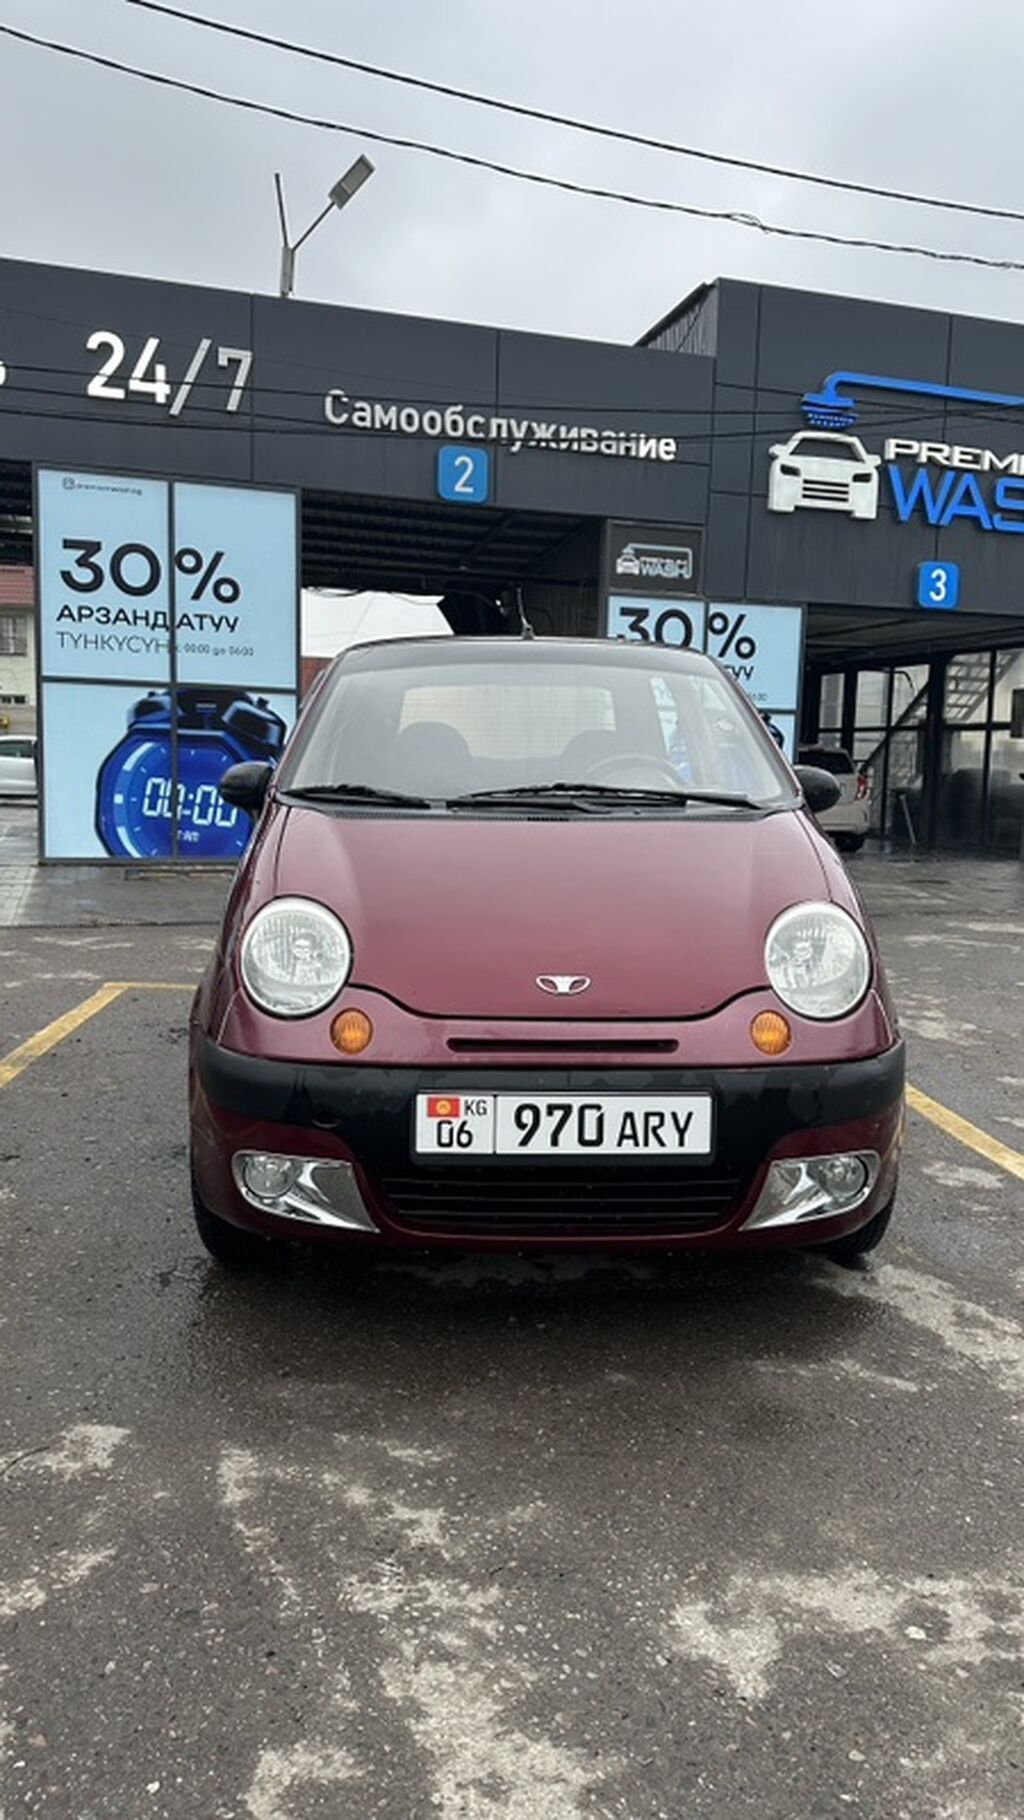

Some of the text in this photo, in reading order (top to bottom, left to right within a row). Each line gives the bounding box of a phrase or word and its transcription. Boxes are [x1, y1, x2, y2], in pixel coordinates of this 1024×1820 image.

[86, 331, 252, 416] 24/7
[324, 389, 677, 461] Самообслуживание
[454, 456, 474, 493] 2
[929, 568, 948, 602] 3
[464, 1099, 487, 1116] KG
[514, 1103, 694, 1148] 970 ARY
[436, 1120, 473, 1149] 06
